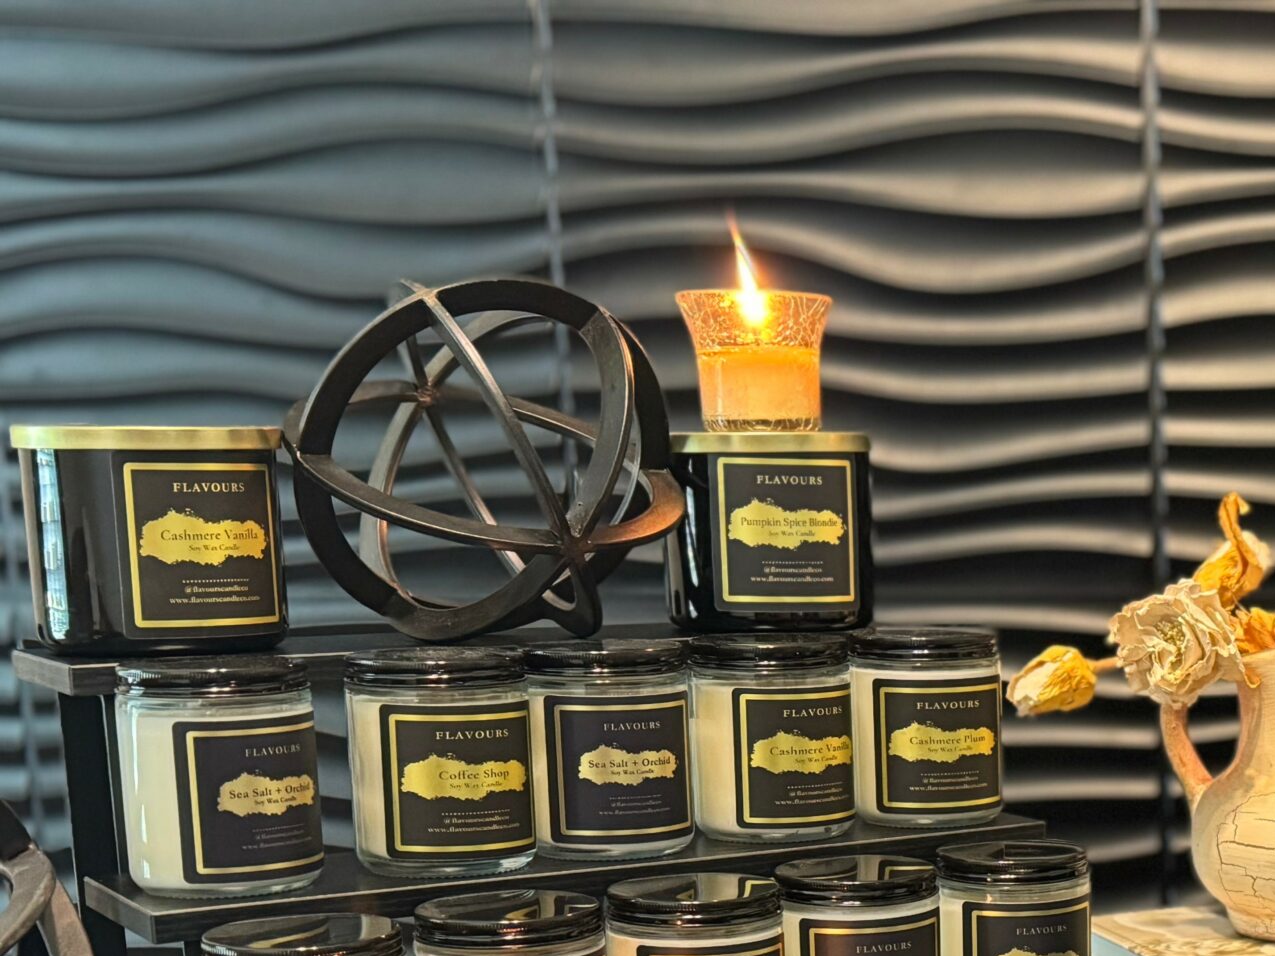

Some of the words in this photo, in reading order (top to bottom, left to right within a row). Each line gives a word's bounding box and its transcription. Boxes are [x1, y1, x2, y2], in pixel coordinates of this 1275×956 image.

[757, 475, 823, 485] FLAVOURS
[173, 482, 245, 493] FLAVOURS
[741, 517, 781, 528] Pumpkin
[783, 518, 807, 527] Spice
[809, 518, 837, 527] Blondie
[161, 530, 221, 541] Cashmere
[224, 529, 258, 540] Vanilla
[916, 700, 980, 710] FLAVOURS
[783, 706, 842, 717] FLAVOURS
[604, 721, 660, 732] FLAVOURS
[436, 729, 508, 740] FLAVOURS
[910, 735, 961, 745] Cashmere
[964, 734, 986, 744] Plum
[246, 744, 301, 758] FLAVOURS
[770, 745, 823, 756] Cashmere
[588, 760, 606, 768] Sea
[610, 760, 629, 768] Salt
[642, 756, 670, 766] Orchid
[439, 770, 480, 780] Coffee
[483, 769, 509, 779] Shop
[229, 790, 249, 799] Sea
[252, 787, 272, 797] Salt
[285, 782, 311, 793] Orchid
[1016, 925, 1067, 935] FLAVOURS
[857, 941, 911, 953] FLAVOURS
